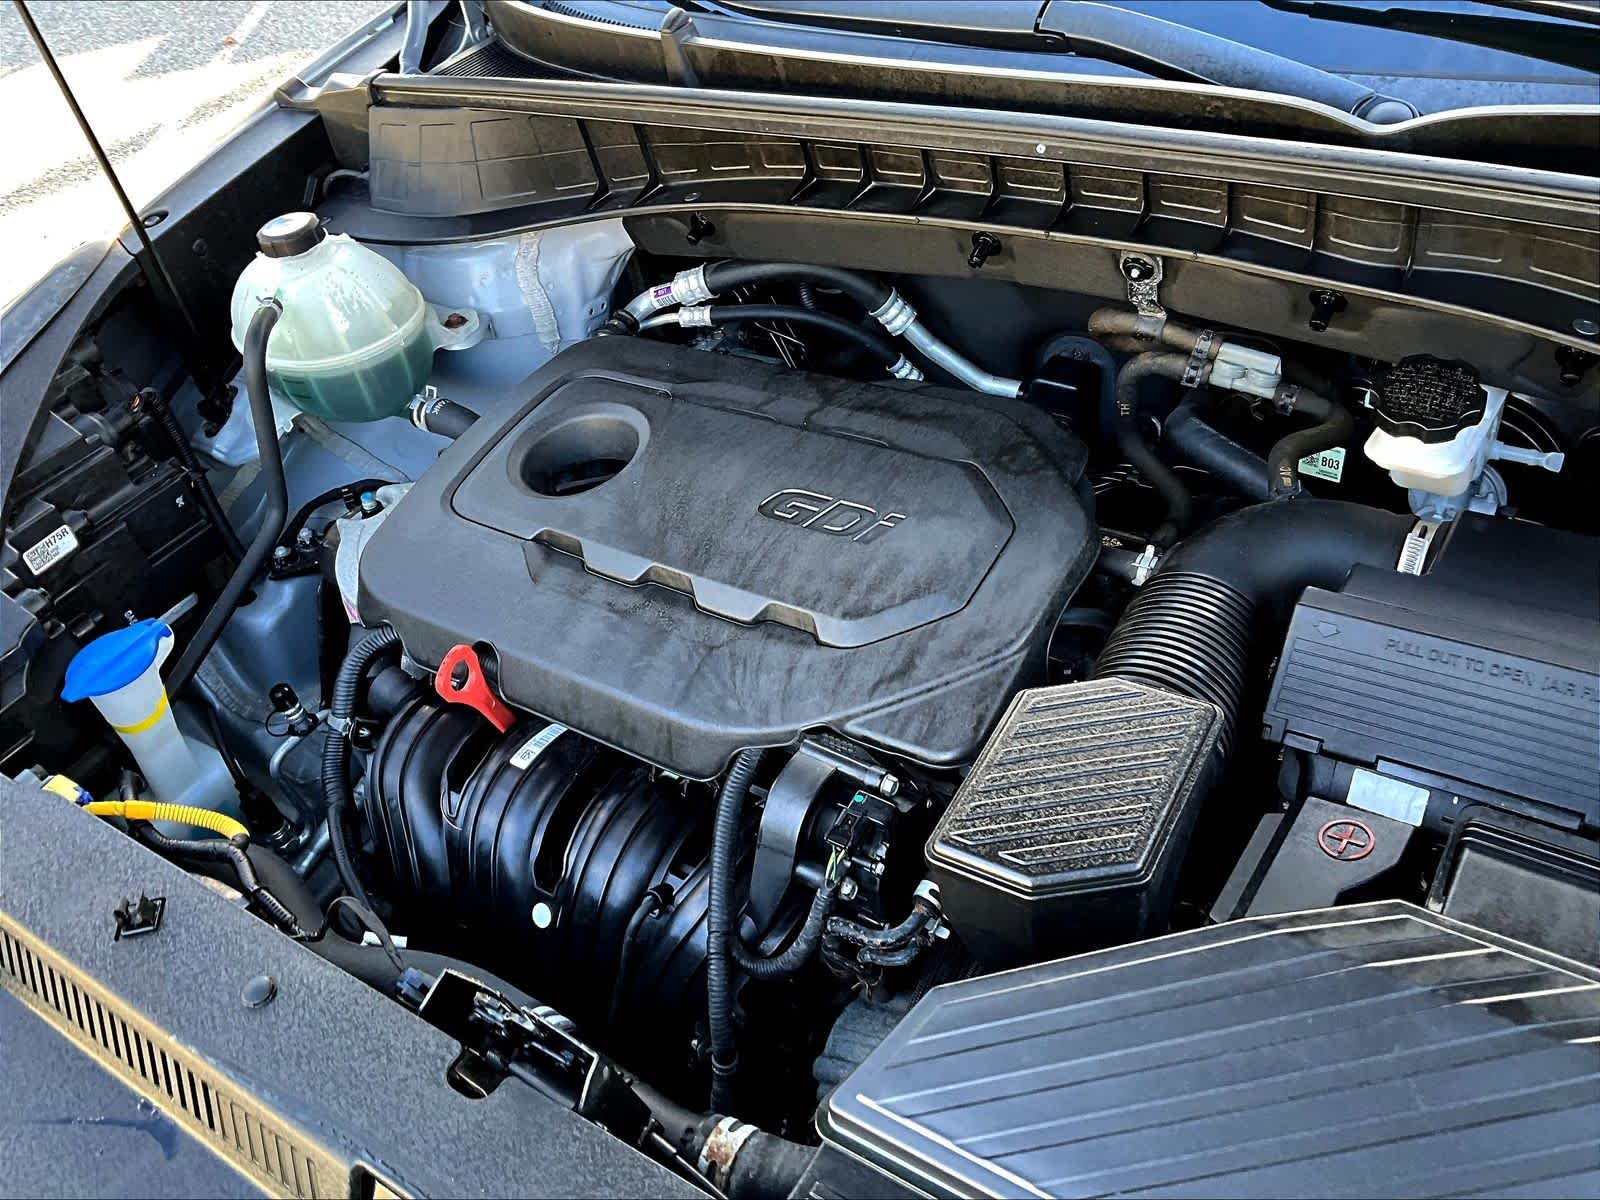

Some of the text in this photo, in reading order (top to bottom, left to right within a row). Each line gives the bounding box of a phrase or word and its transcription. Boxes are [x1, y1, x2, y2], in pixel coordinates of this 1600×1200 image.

[1320, 456, 1340, 470] B03
[45, 527, 70, 548] H75R
[1384, 638, 1424, 659] PULL
[1427, 648, 1462, 667] OUT
[1465, 656, 1486, 673] TO
[1488, 663, 1536, 687] OPEN
